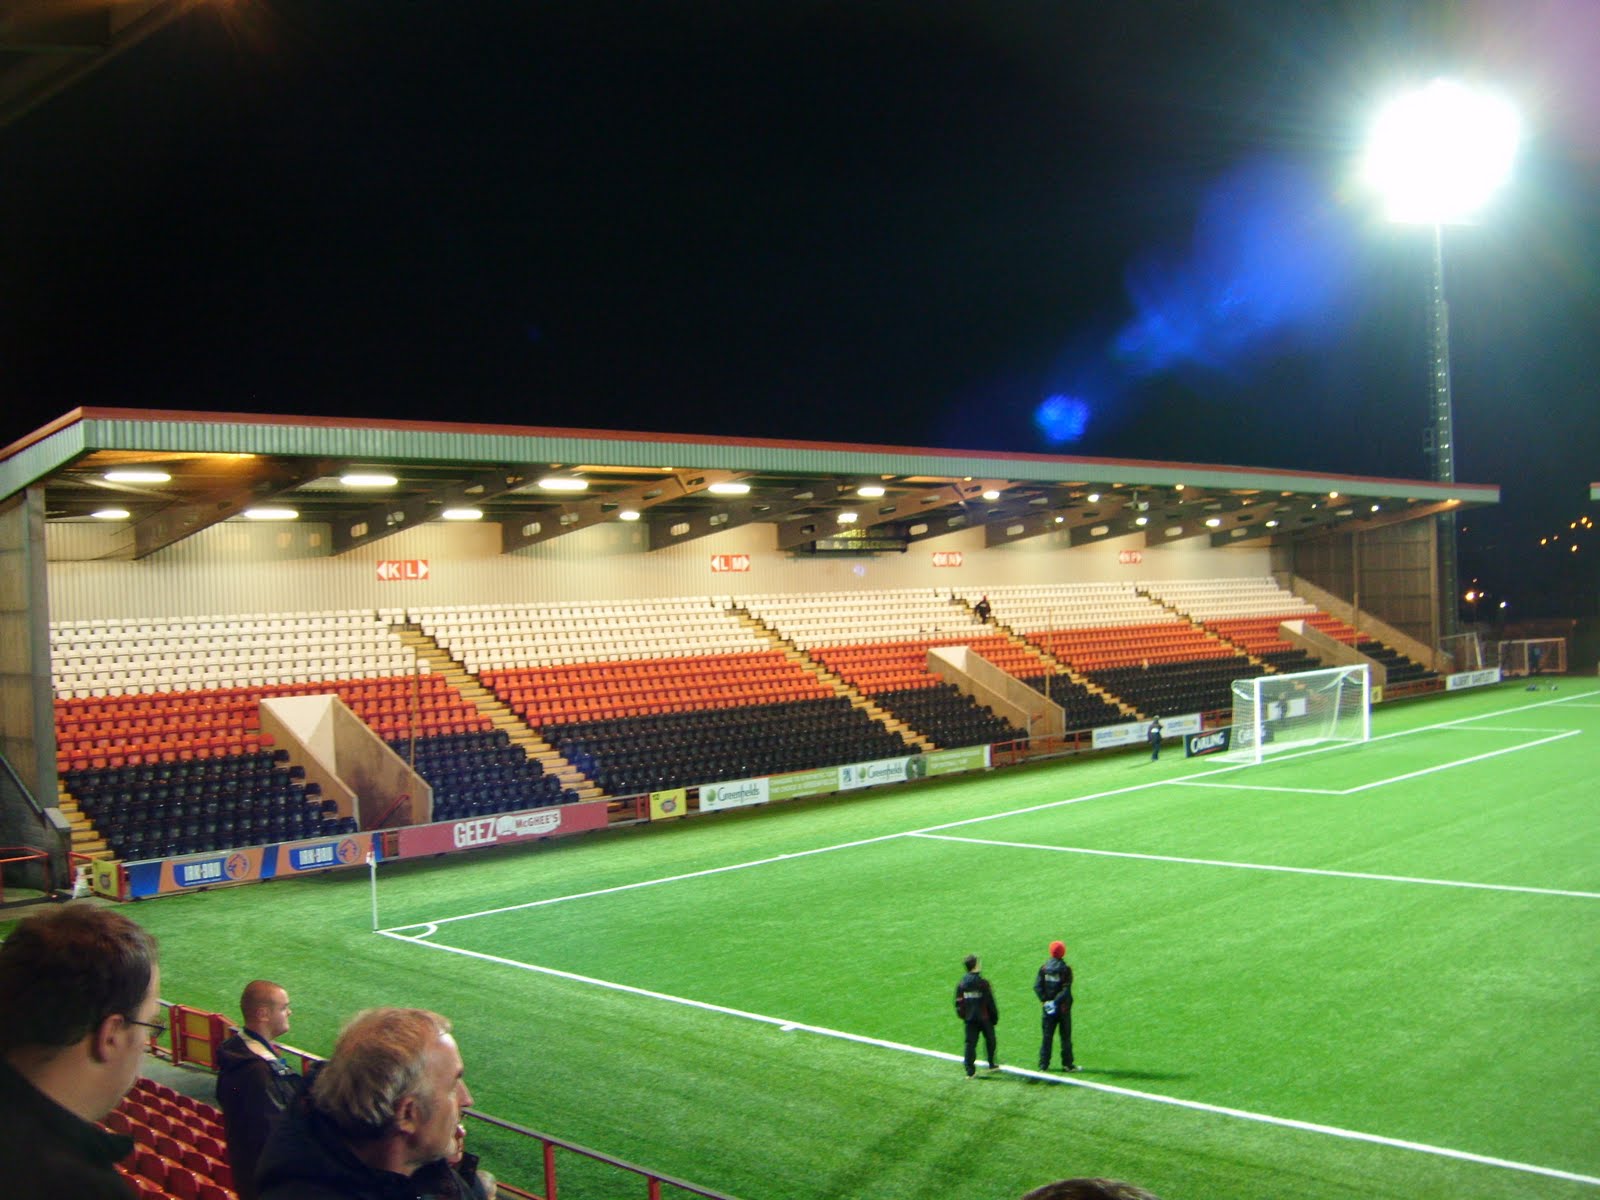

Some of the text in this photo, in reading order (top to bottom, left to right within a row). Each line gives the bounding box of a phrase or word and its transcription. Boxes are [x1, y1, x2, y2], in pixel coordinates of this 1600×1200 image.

[388, 562, 418, 578] K L
[720, 557, 729, 570] L
[1190, 731, 1225, 754] CARLING
[867, 761, 903, 780] Greenfields
[717, 783, 760, 803] Greenfields
[453, 817, 498, 848] GEEZ
